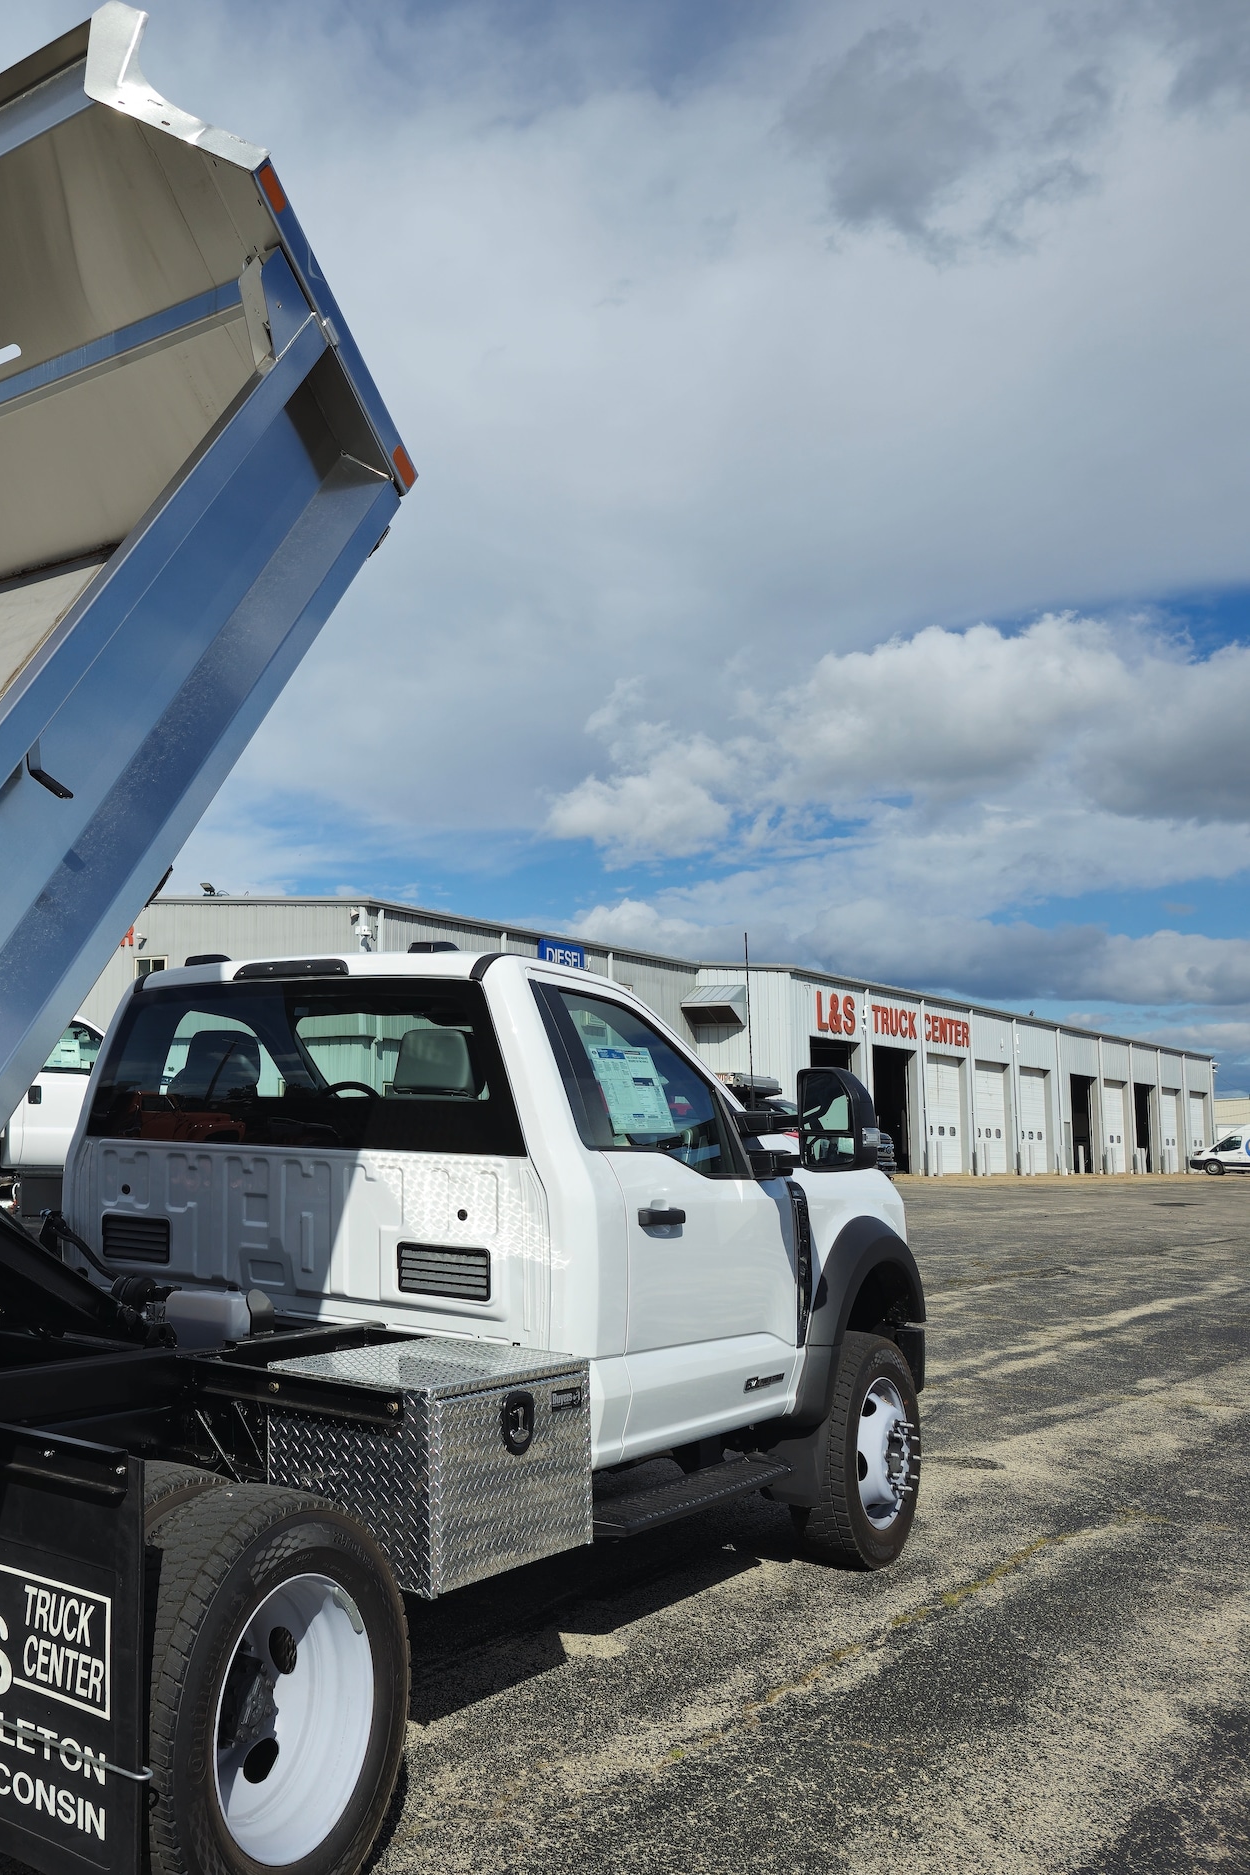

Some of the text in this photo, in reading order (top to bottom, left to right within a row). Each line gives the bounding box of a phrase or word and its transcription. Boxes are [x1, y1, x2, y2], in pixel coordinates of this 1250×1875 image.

[546, 947, 584, 970] DIESEL
[816, 990, 970, 1048] L&S TRUCK CENTER
[23, 1584, 96, 1648] TRUCK
[23, 1634, 105, 1703] CENTER
